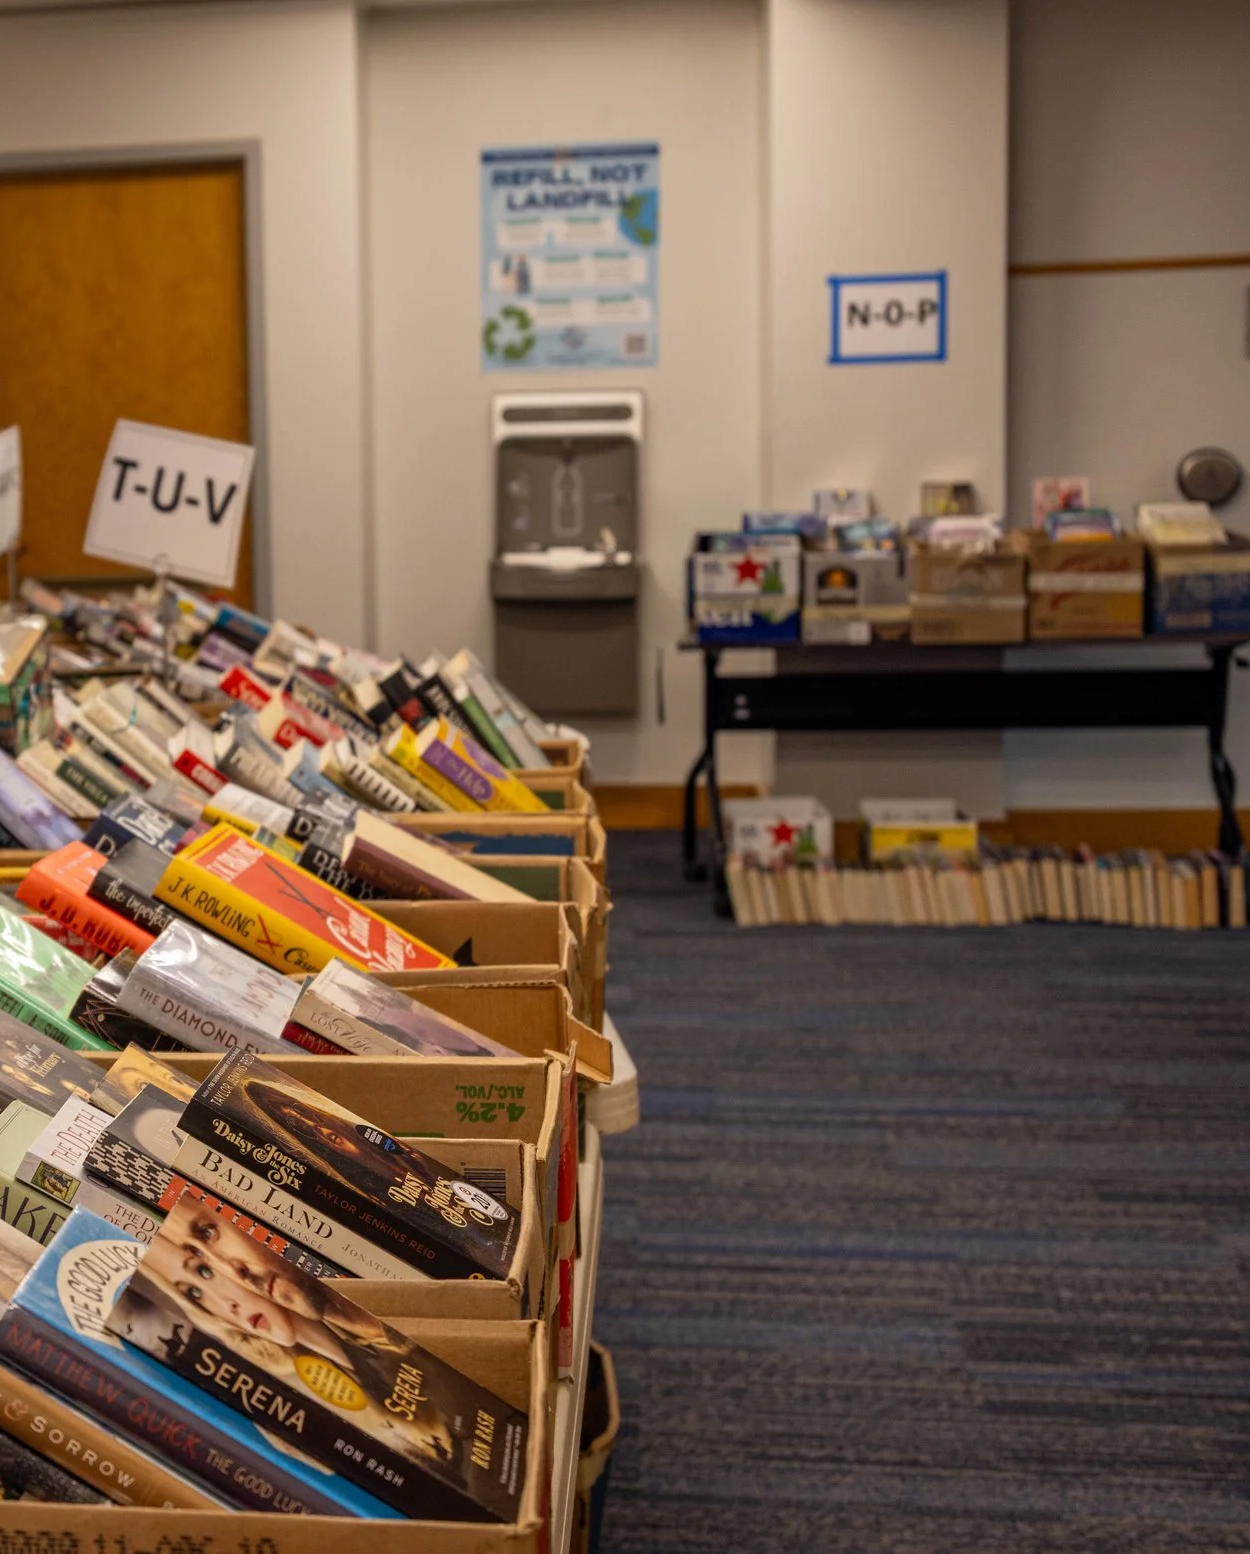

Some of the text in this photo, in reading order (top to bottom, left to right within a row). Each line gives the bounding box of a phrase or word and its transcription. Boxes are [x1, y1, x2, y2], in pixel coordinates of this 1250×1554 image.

[590, 163, 647, 184] NOT
[112, 456, 238, 525] T-U-V
[458, 767, 486, 797] Help
[104, 877, 126, 900] the
[166, 876, 194, 908] J.K.
[192, 888, 256, 939] ROWLING
[139, 986, 239, 1047] THE DIAMOND
[310, 1011, 345, 1034] LOST
[210, 1083, 234, 1107] TAYLOR
[455, 1084, 525, 1099] ALC./VOL.
[455, 1102, 526, 1123] 4.2%
[51, 1108, 107, 1166] THE DEATH
[212, 1118, 255, 1156] Daisy
[264, 1143, 308, 1175] Jones
[267, 1165, 302, 1191] Six
[269, 1160, 281, 1170] the
[387, 1171, 434, 1208] Daisy
[116, 1204, 141, 1226] THE
[199, 1149, 333, 1240] BAD LAND
[211, 1179, 267, 1217] AMERICAN
[272, 1216, 324, 1251] ROMANCE
[423, 1175, 455, 1209] Jones
[314, 1184, 436, 1260] TAYLOR JENKINS REID
[341, 1243, 403, 1280] JONATHA
[67, 1244, 141, 1337] THE GOOD LUCK
[4, 1323, 125, 1403] MATTHEW
[126, 1394, 199, 1462] QUICK
[204, 1447, 232, 1477] THE
[230, 1461, 275, 1500] GOOD
[194, 1347, 307, 1435] SERENA
[383, 1362, 429, 1422] SERENA
[3, 1400, 29, 1421] &
[29, 1416, 136, 1489] SORROW
[333, 1438, 405, 1488] RON RASH
[470, 1408, 497, 1471] RON RASH
